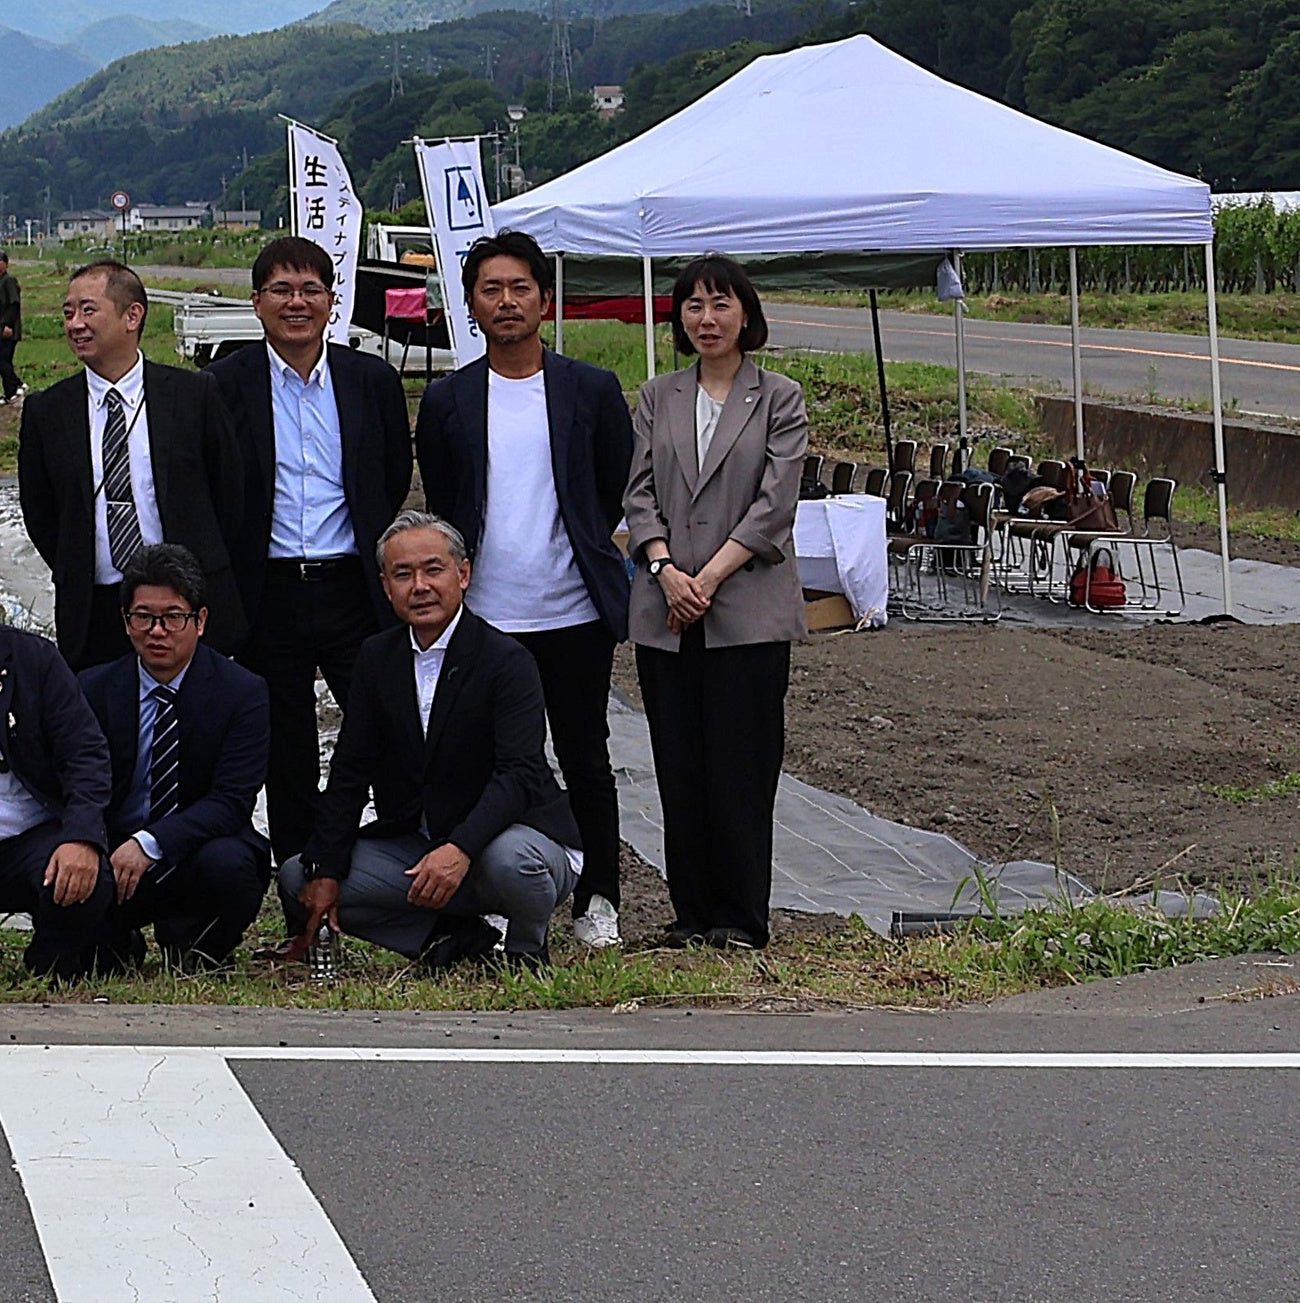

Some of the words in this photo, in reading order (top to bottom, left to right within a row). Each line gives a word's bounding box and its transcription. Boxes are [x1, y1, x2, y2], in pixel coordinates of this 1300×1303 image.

[304, 155, 328, 243] 生活
[327, 165, 351, 341] ステイナブルなひと
